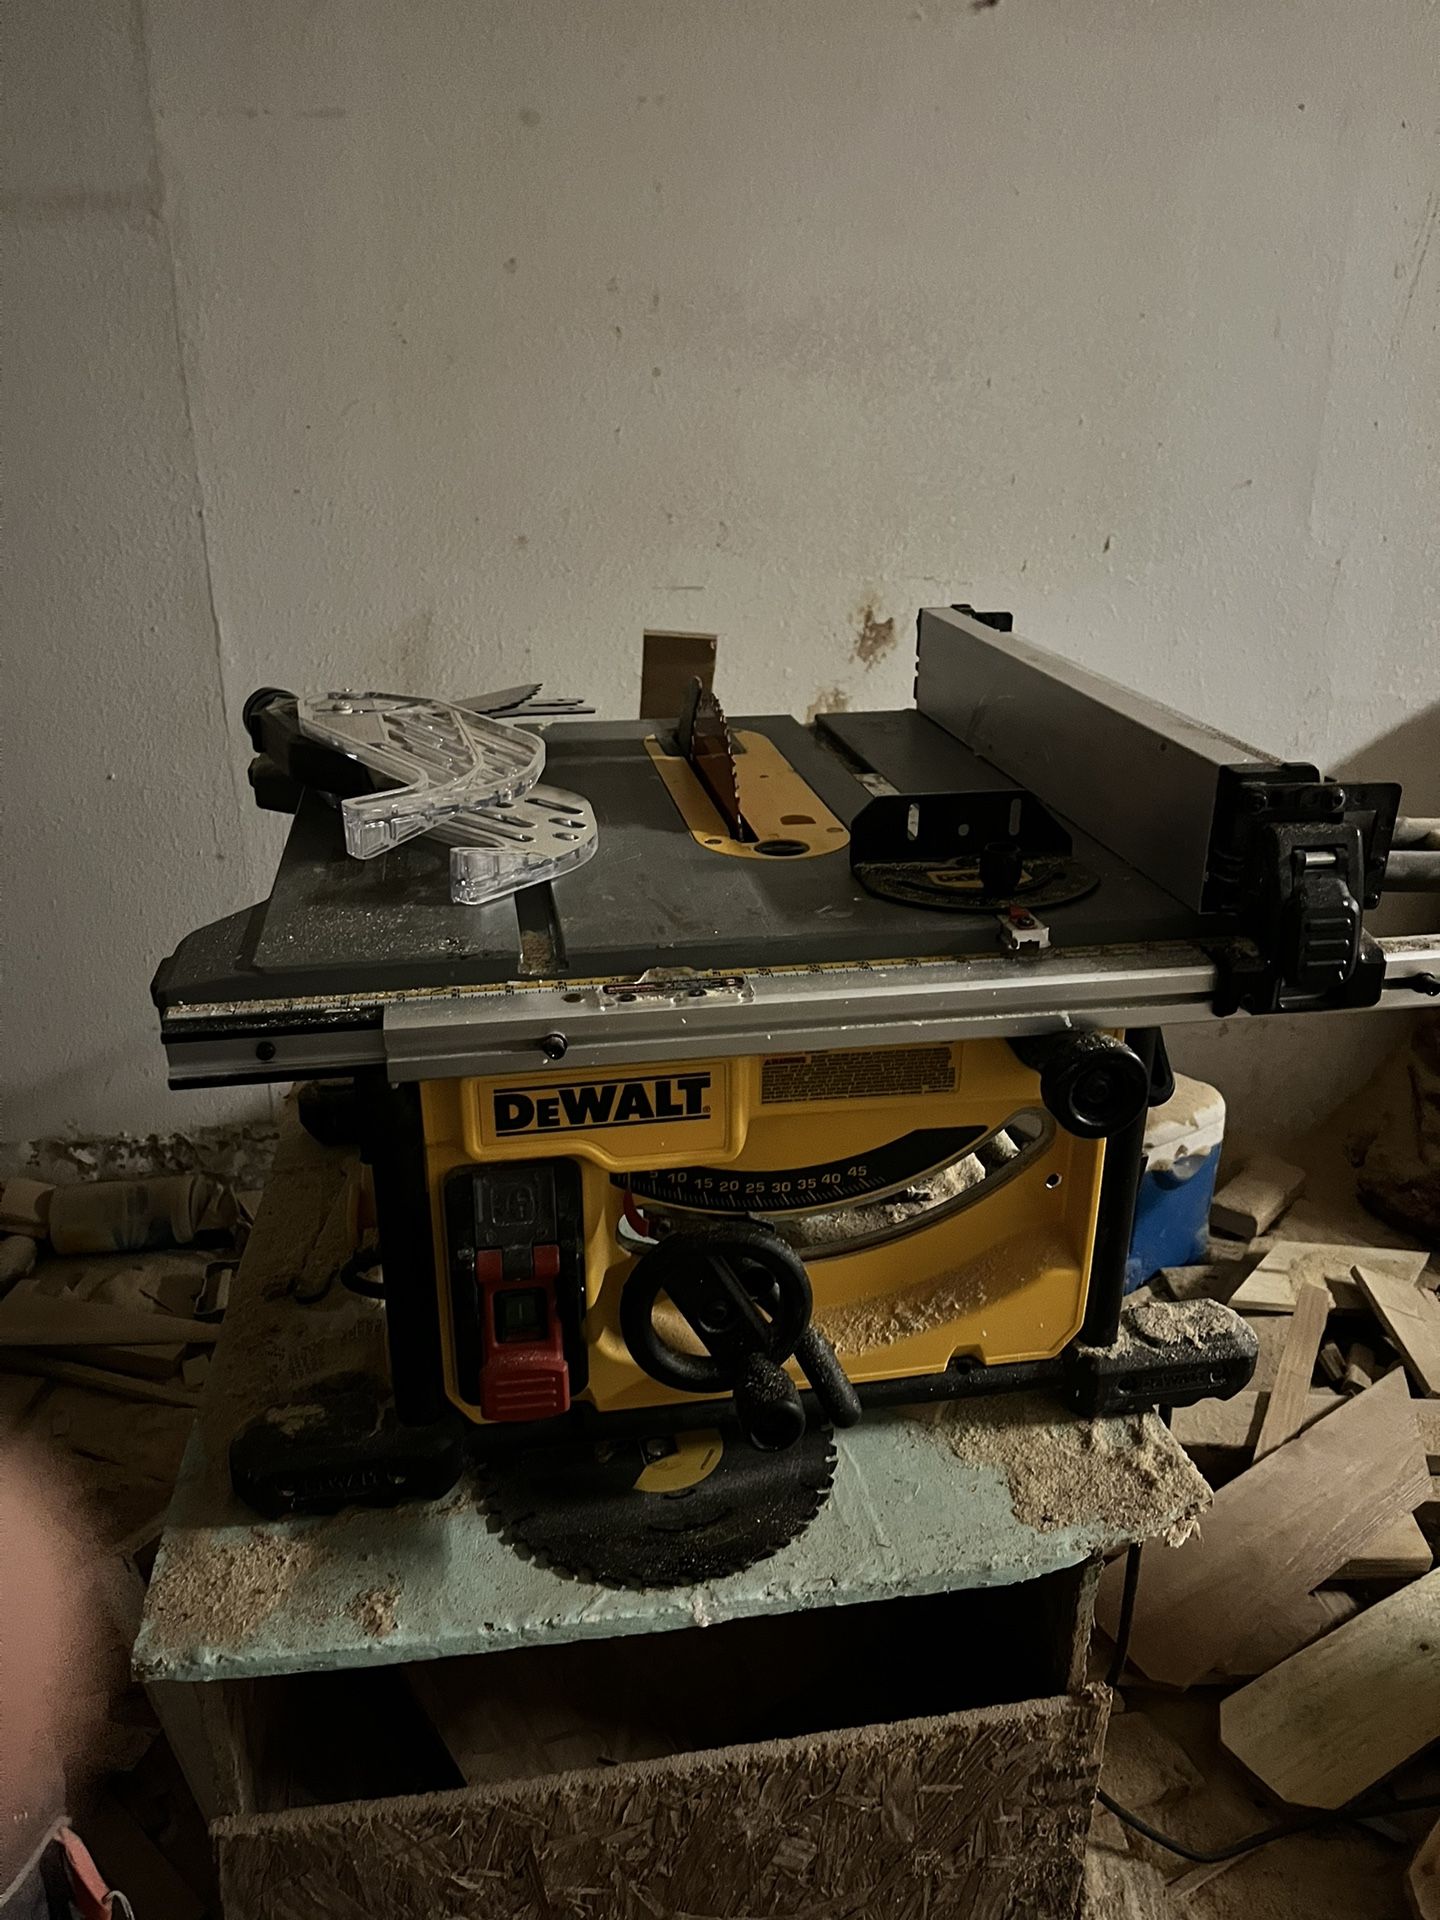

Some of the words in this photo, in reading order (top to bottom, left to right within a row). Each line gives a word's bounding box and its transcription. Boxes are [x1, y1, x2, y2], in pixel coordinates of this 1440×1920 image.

[667, 1171, 688, 1183] 10
[693, 1177, 714, 1189] 15
[719, 1180, 740, 1192] 20
[745, 1181, 766, 1193] 25
[771, 1181, 792, 1193] 30
[796, 1178, 817, 1190] 35
[821, 1173, 842, 1184] 40
[847, 1165, 868, 1177] 45
